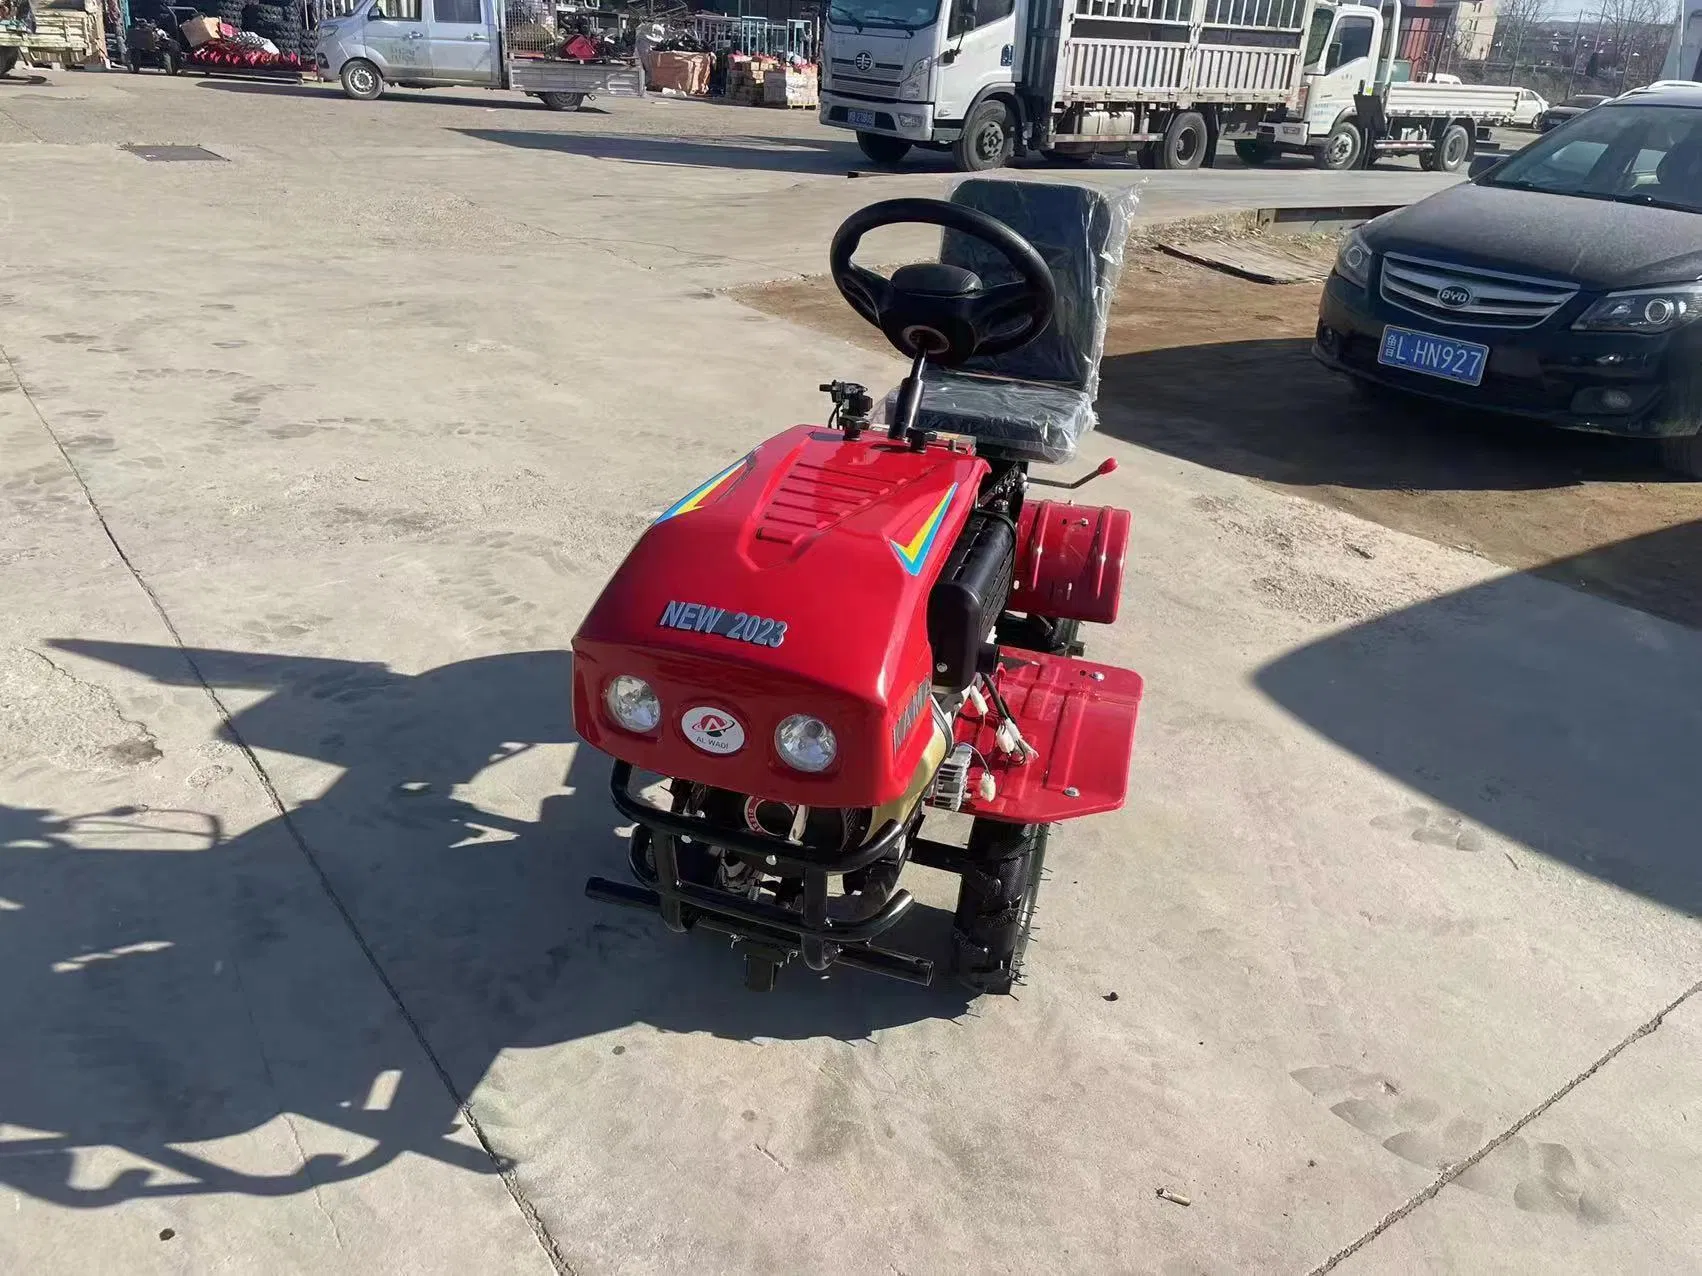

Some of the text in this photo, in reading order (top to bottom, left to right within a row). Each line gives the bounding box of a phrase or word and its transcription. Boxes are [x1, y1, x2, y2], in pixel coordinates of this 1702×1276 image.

[1441, 289, 1467, 302] BYD
[659, 600, 788, 648] NEW 2023
[696, 736, 729, 750] AL WADI
